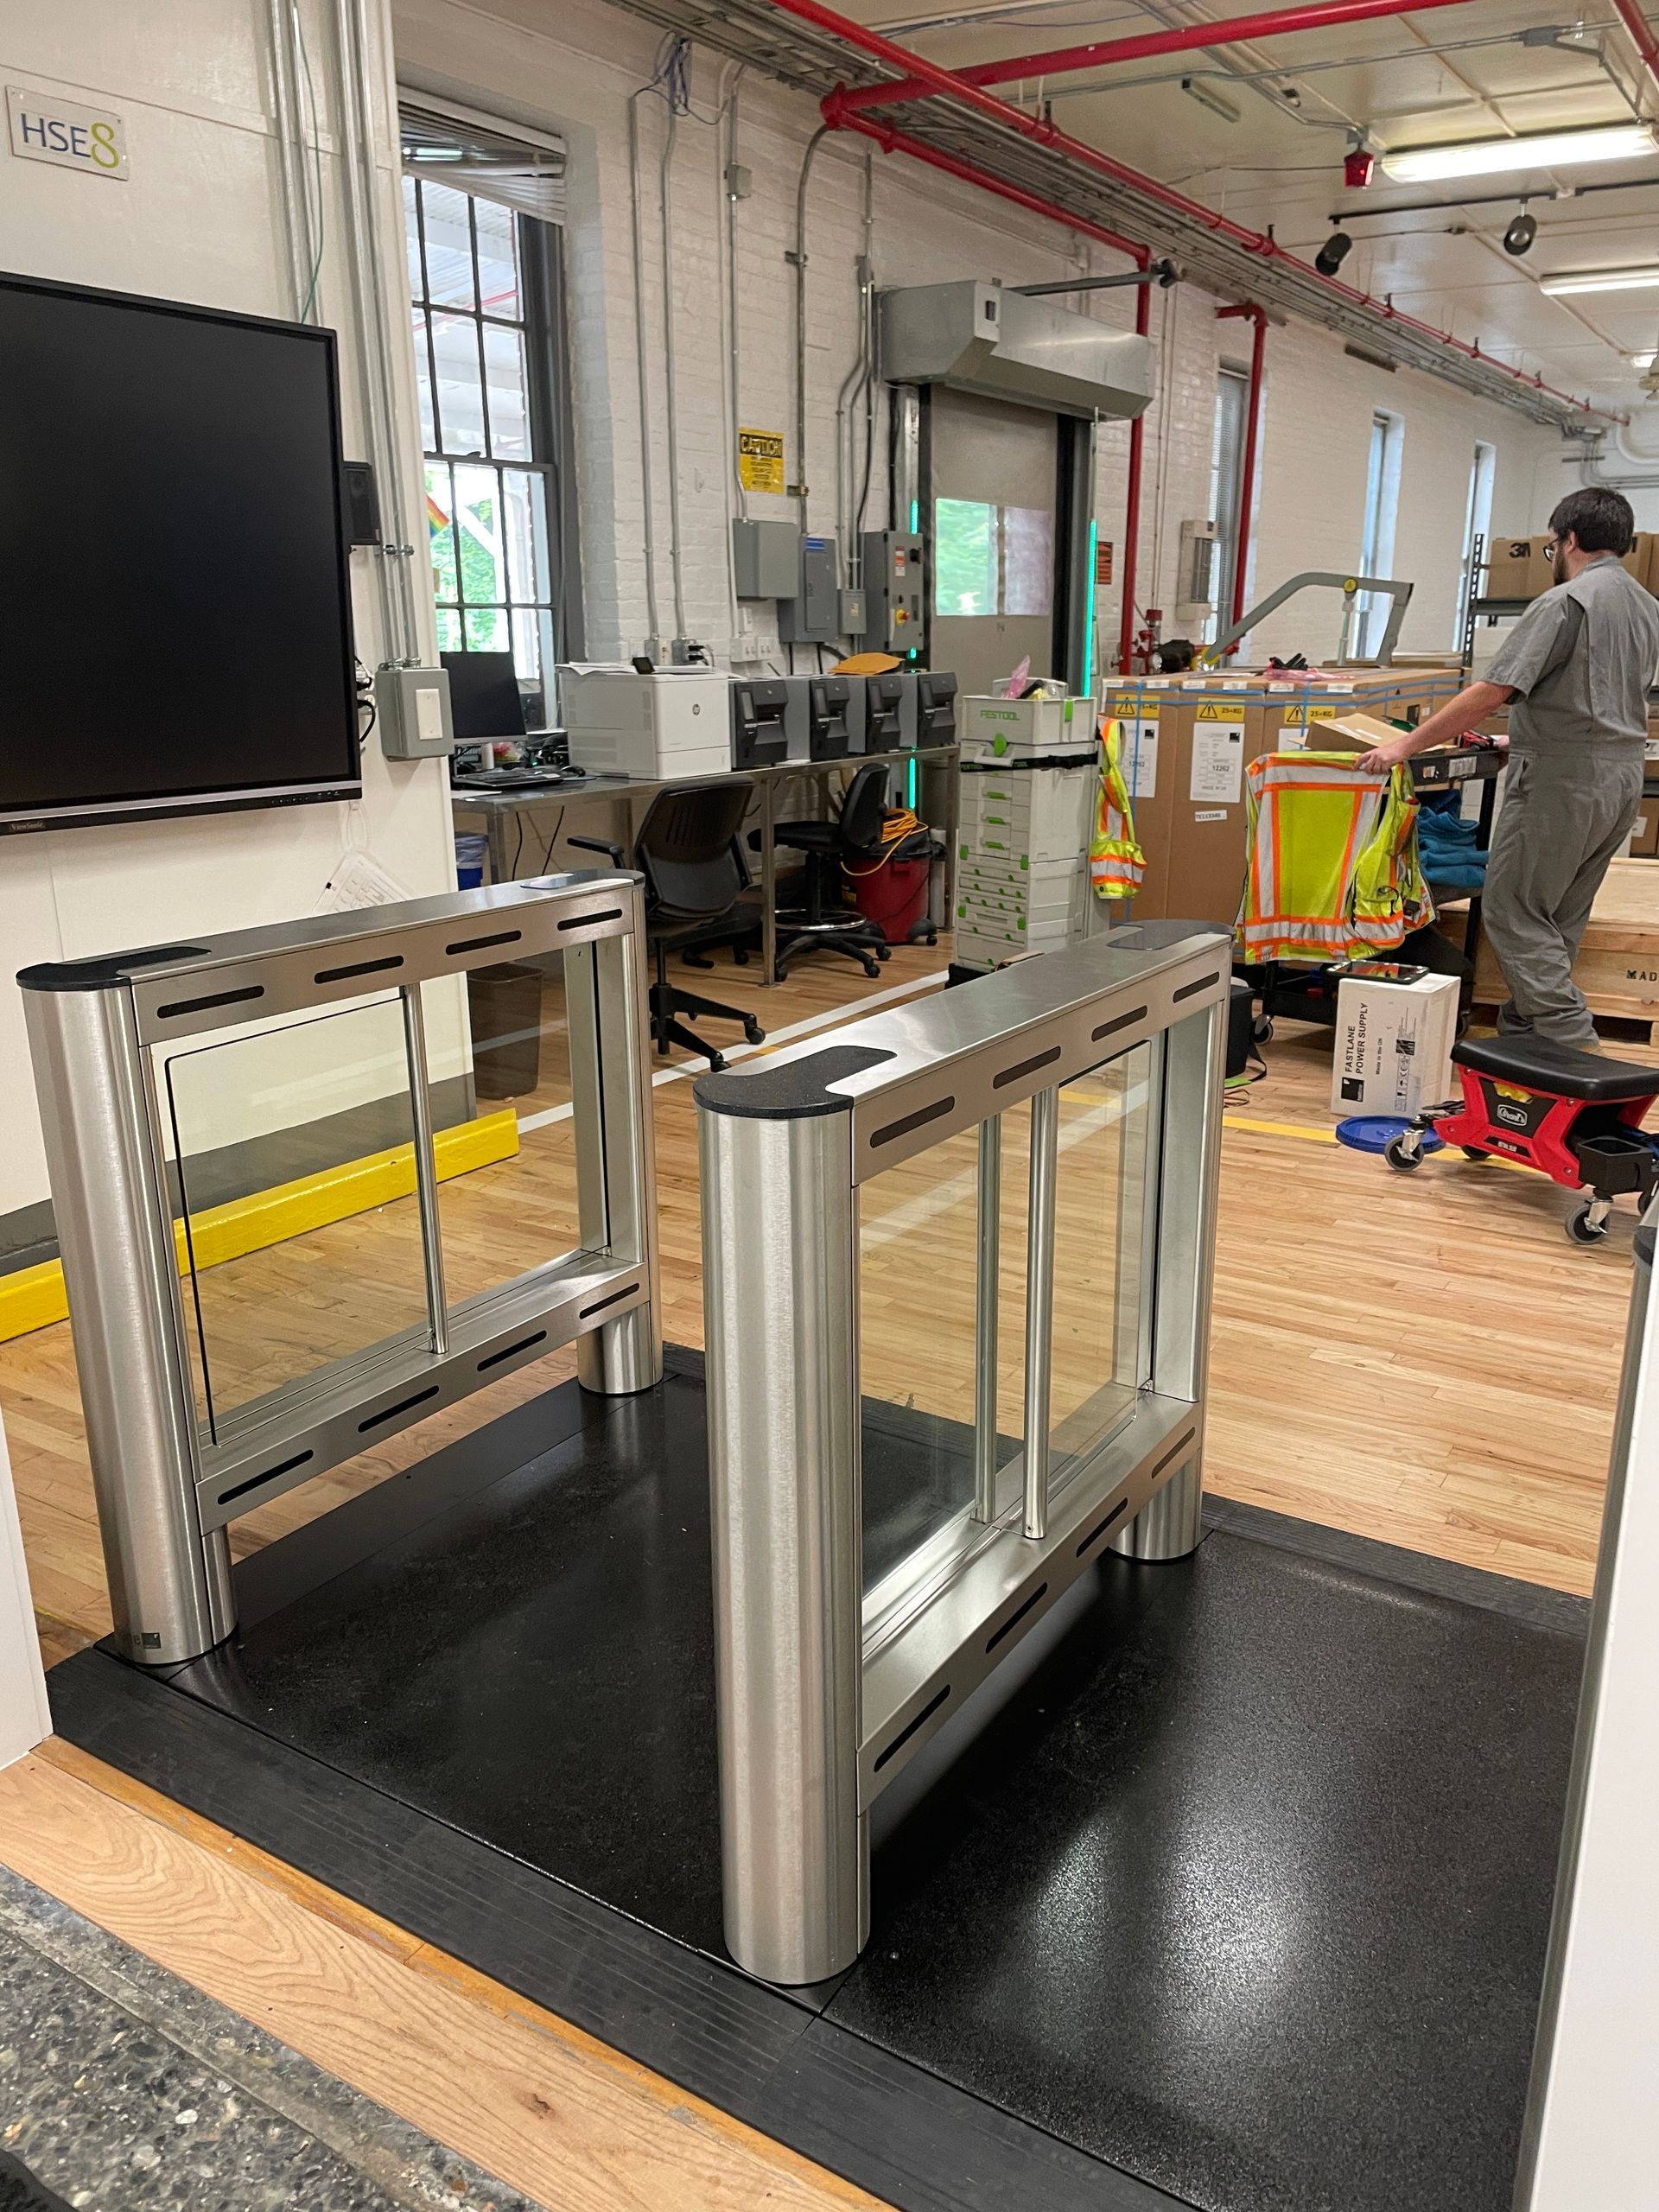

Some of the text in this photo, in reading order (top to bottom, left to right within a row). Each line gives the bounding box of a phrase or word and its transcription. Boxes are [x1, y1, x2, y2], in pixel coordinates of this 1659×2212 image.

[980, 709, 1020, 721] FESTOOL
[1344, 1026, 1356, 1072] FASTLANE
[1355, 1002, 1368, 1074] POWER SUPPLY
